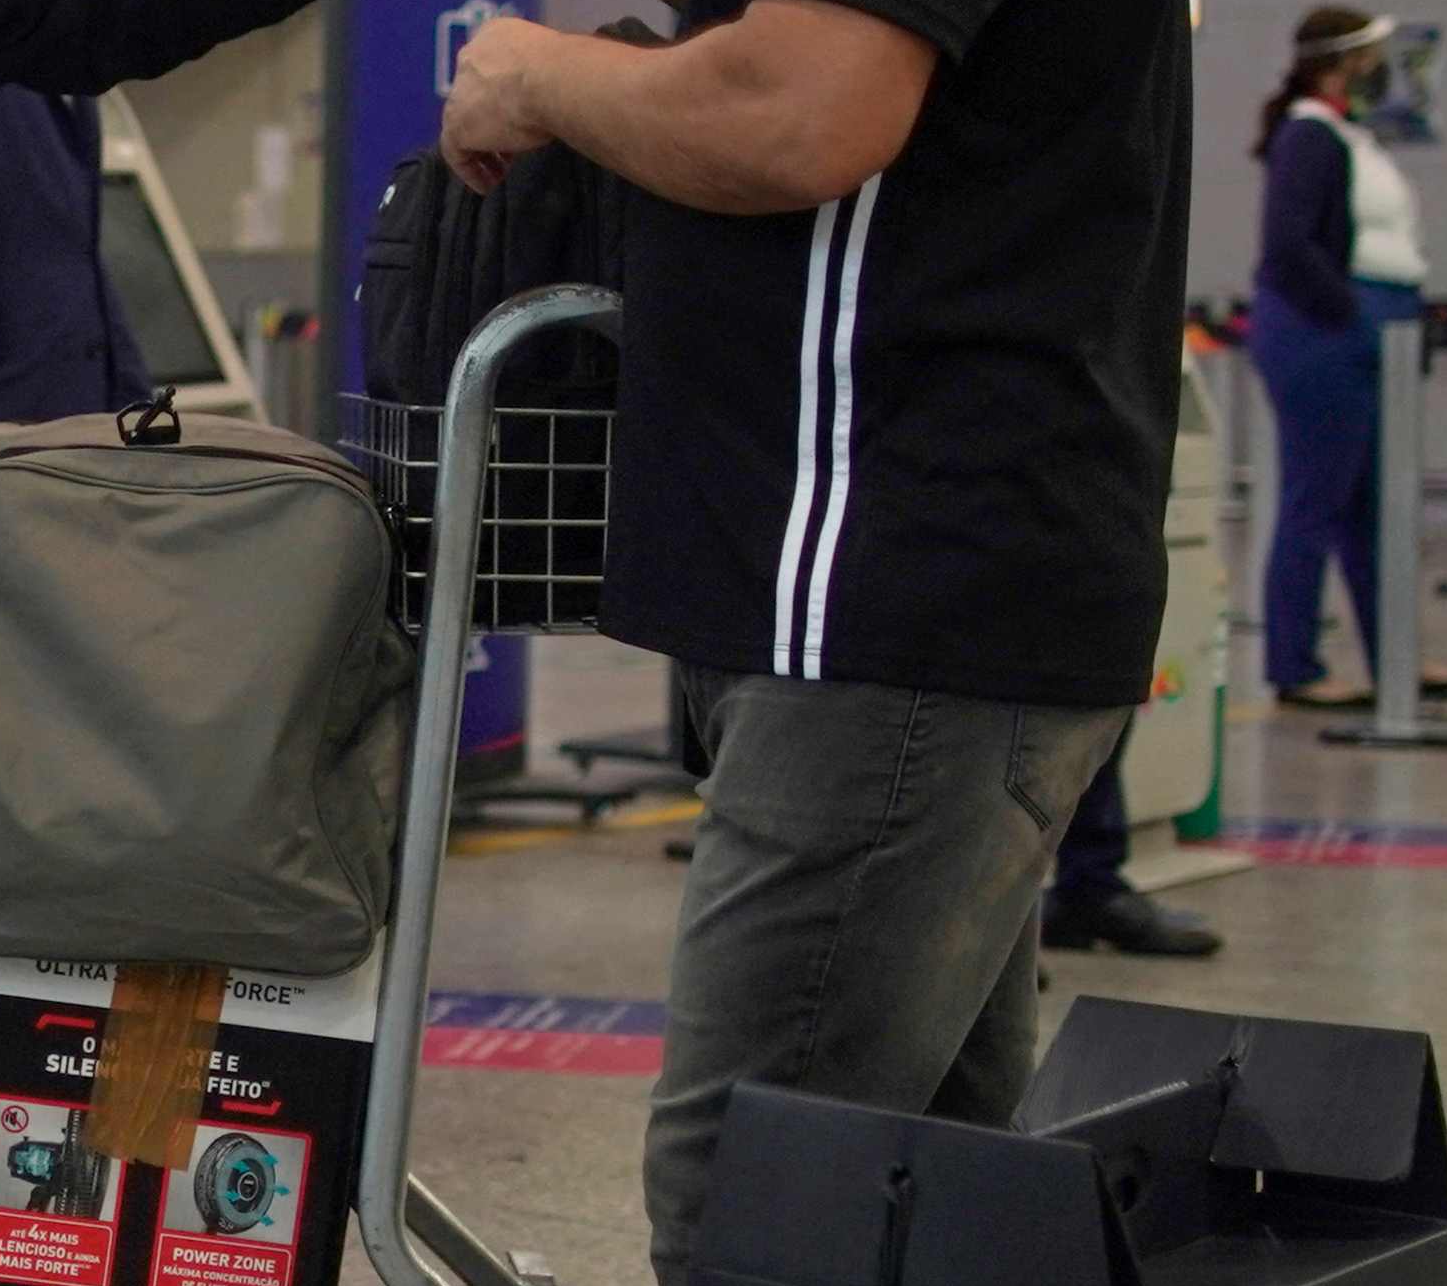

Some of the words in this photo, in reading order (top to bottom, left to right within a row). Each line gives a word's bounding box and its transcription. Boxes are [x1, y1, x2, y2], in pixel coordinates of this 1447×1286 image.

[49, 1232, 79, 1246] MAIS
[0, 1254, 33, 1270] MAIS
[35, 1259, 80, 1277] FORTE
[172, 1247, 230, 1268] POWER
[232, 1255, 277, 1274] ZONE
[163, 1265, 202, 1280] MÁXIMA
